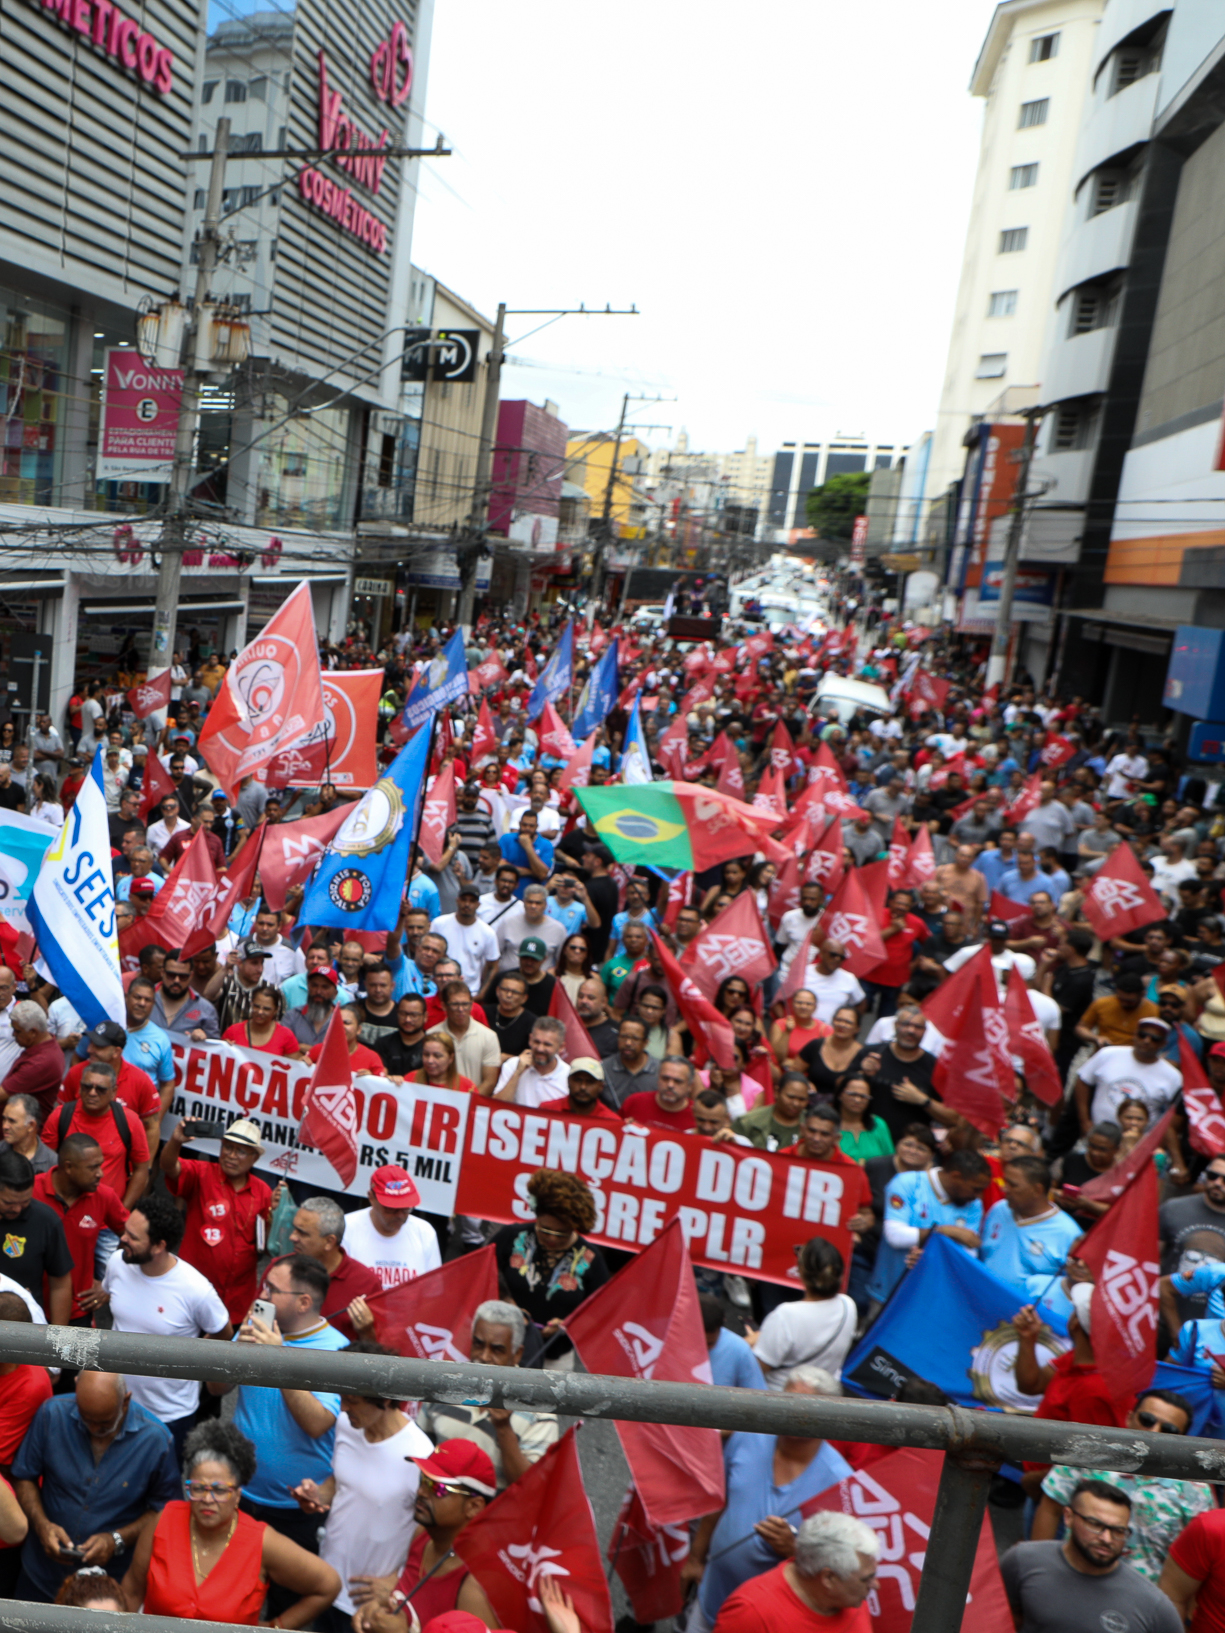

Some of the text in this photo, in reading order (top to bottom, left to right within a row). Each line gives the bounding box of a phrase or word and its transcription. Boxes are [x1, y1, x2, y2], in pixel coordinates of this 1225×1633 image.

[319, 50, 388, 194] VONNY
[299, 163, 387, 253] COSMÉTICOS
[439, 346, 459, 366] M
[141, 401, 153, 419] E
[107, 446, 128, 454] PELA
[130, 446, 146, 454] RUA
[148, 447, 159, 455] DE
[108, 437, 176, 447] PARA CLIENTE
[63, 850, 117, 938] SEES
[172, 1043, 313, 1122] SENÇÃO
[409, 1099, 460, 1154] IR
[360, 1144, 389, 1168] R$
[414, 1156, 453, 1184] MIL
[471, 1104, 844, 1228] ISENÇÃO DO IR
[209, 1203, 226, 1218] 13
[511, 1172, 765, 1270] SBRE PLR
[204, 1227, 221, 1242] 13
[376, 1266, 417, 1285] RNADA
